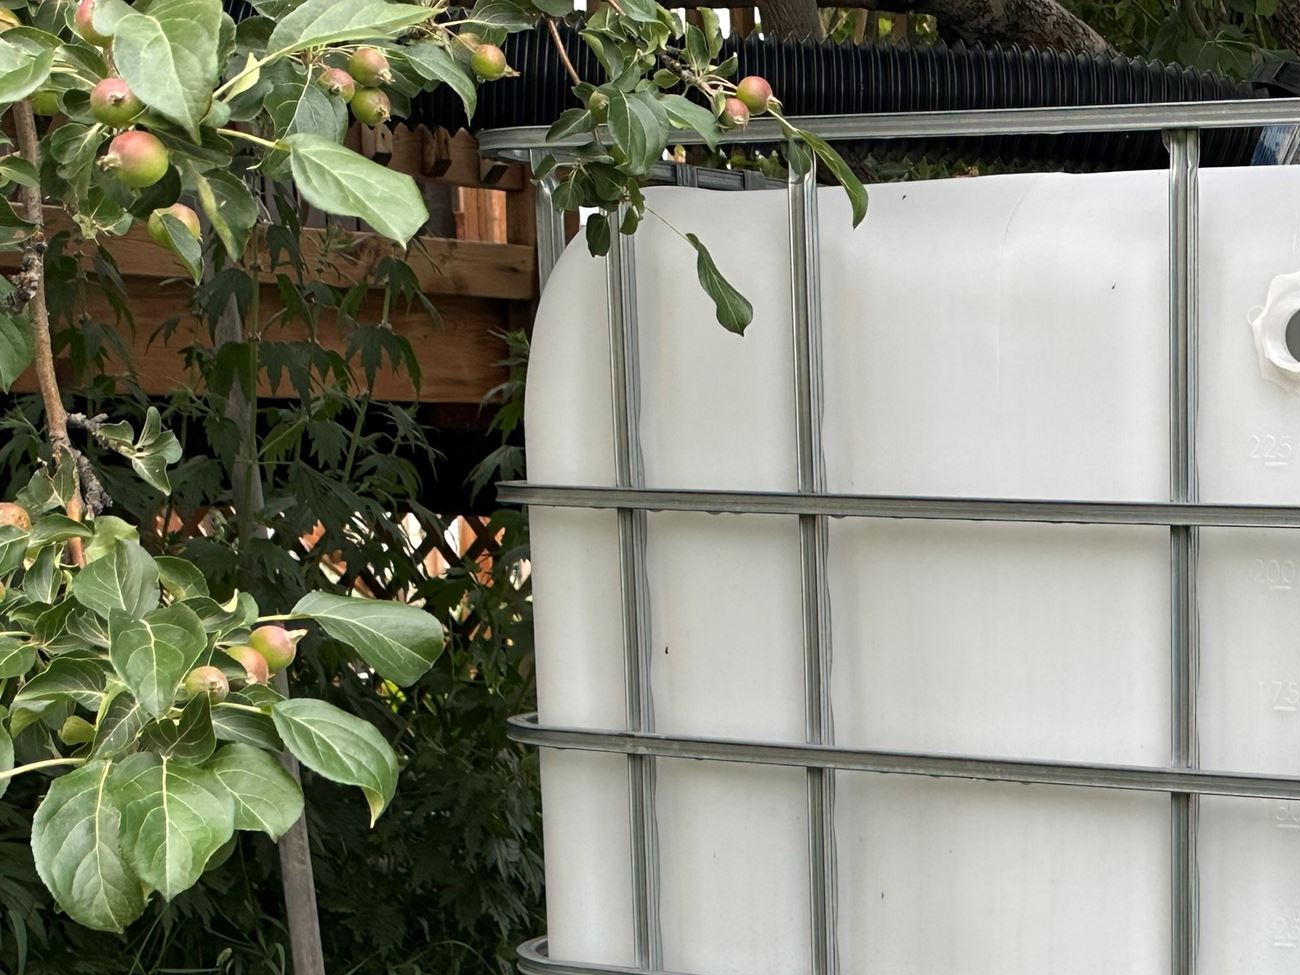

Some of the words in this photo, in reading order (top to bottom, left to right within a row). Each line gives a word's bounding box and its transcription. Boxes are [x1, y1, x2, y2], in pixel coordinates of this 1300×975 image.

[1248, 434, 1293, 459] 225
[1253, 558, 1297, 583] 200
[1256, 680, 1300, 704] 175
